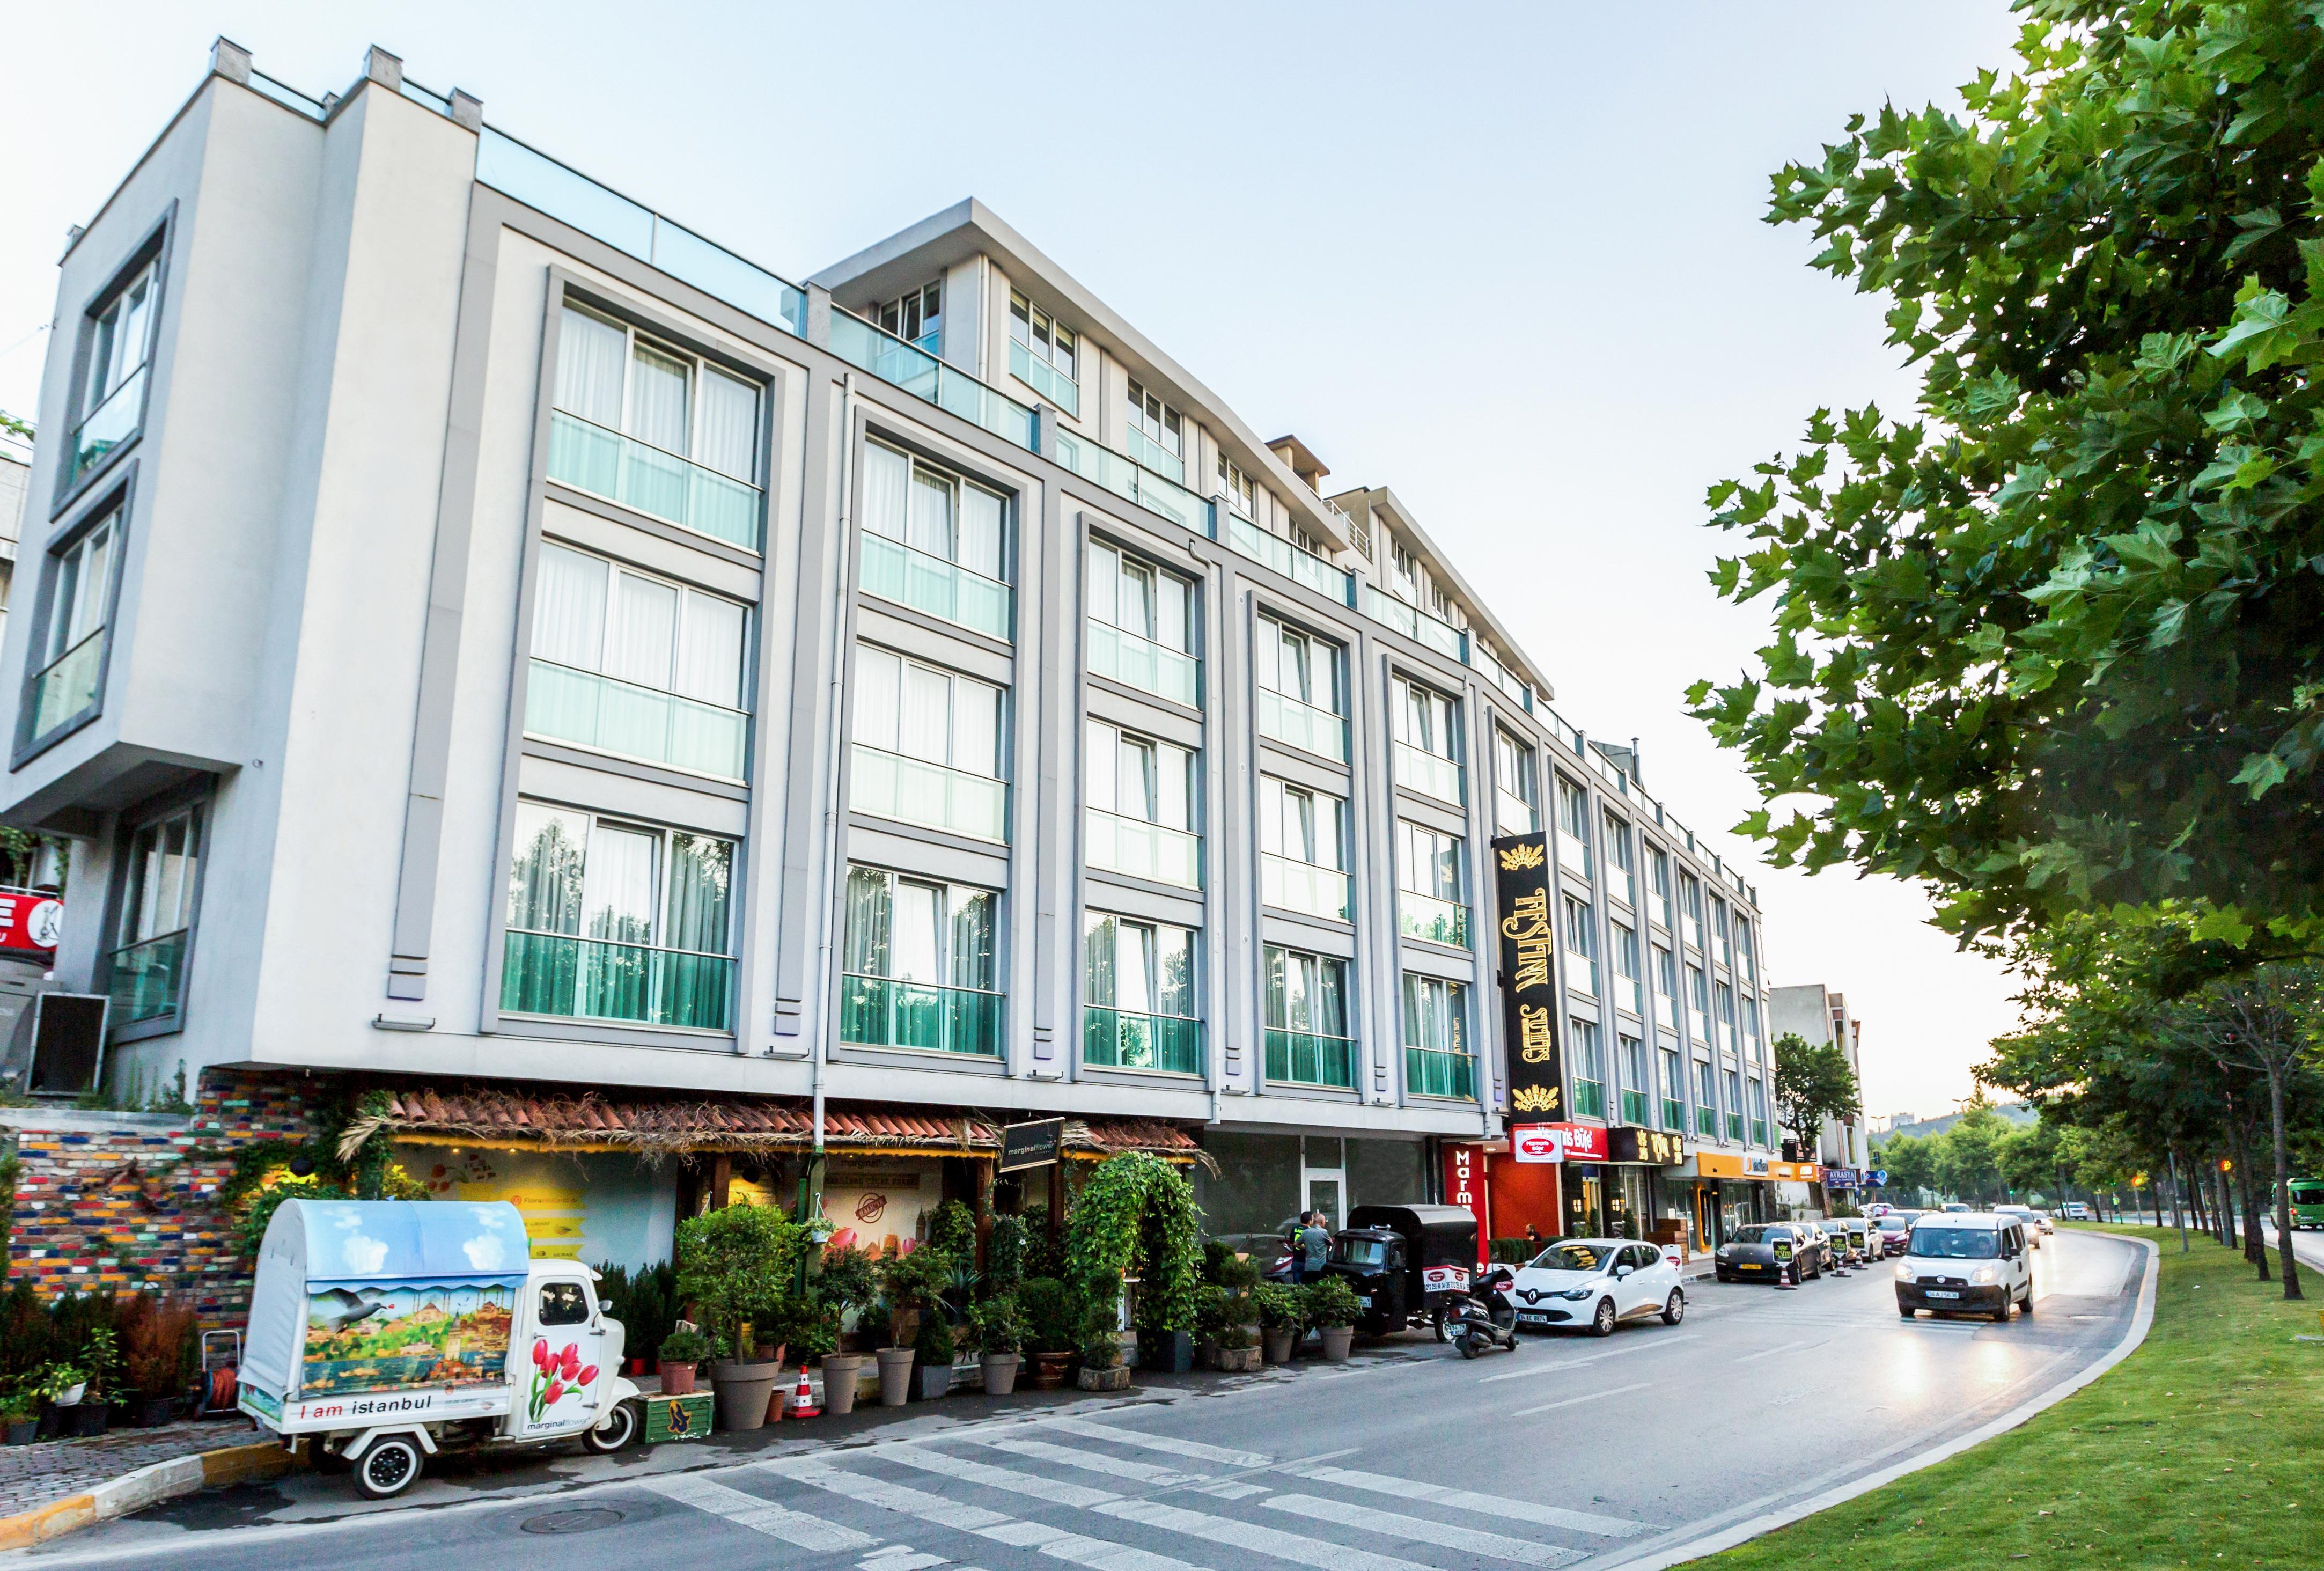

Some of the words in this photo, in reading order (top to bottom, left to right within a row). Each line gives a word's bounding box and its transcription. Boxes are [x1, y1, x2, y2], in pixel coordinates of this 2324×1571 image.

[300, 1405, 306, 1419] I
[313, 1404, 343, 1418] am
[352, 1395, 431, 1414] istanbul
